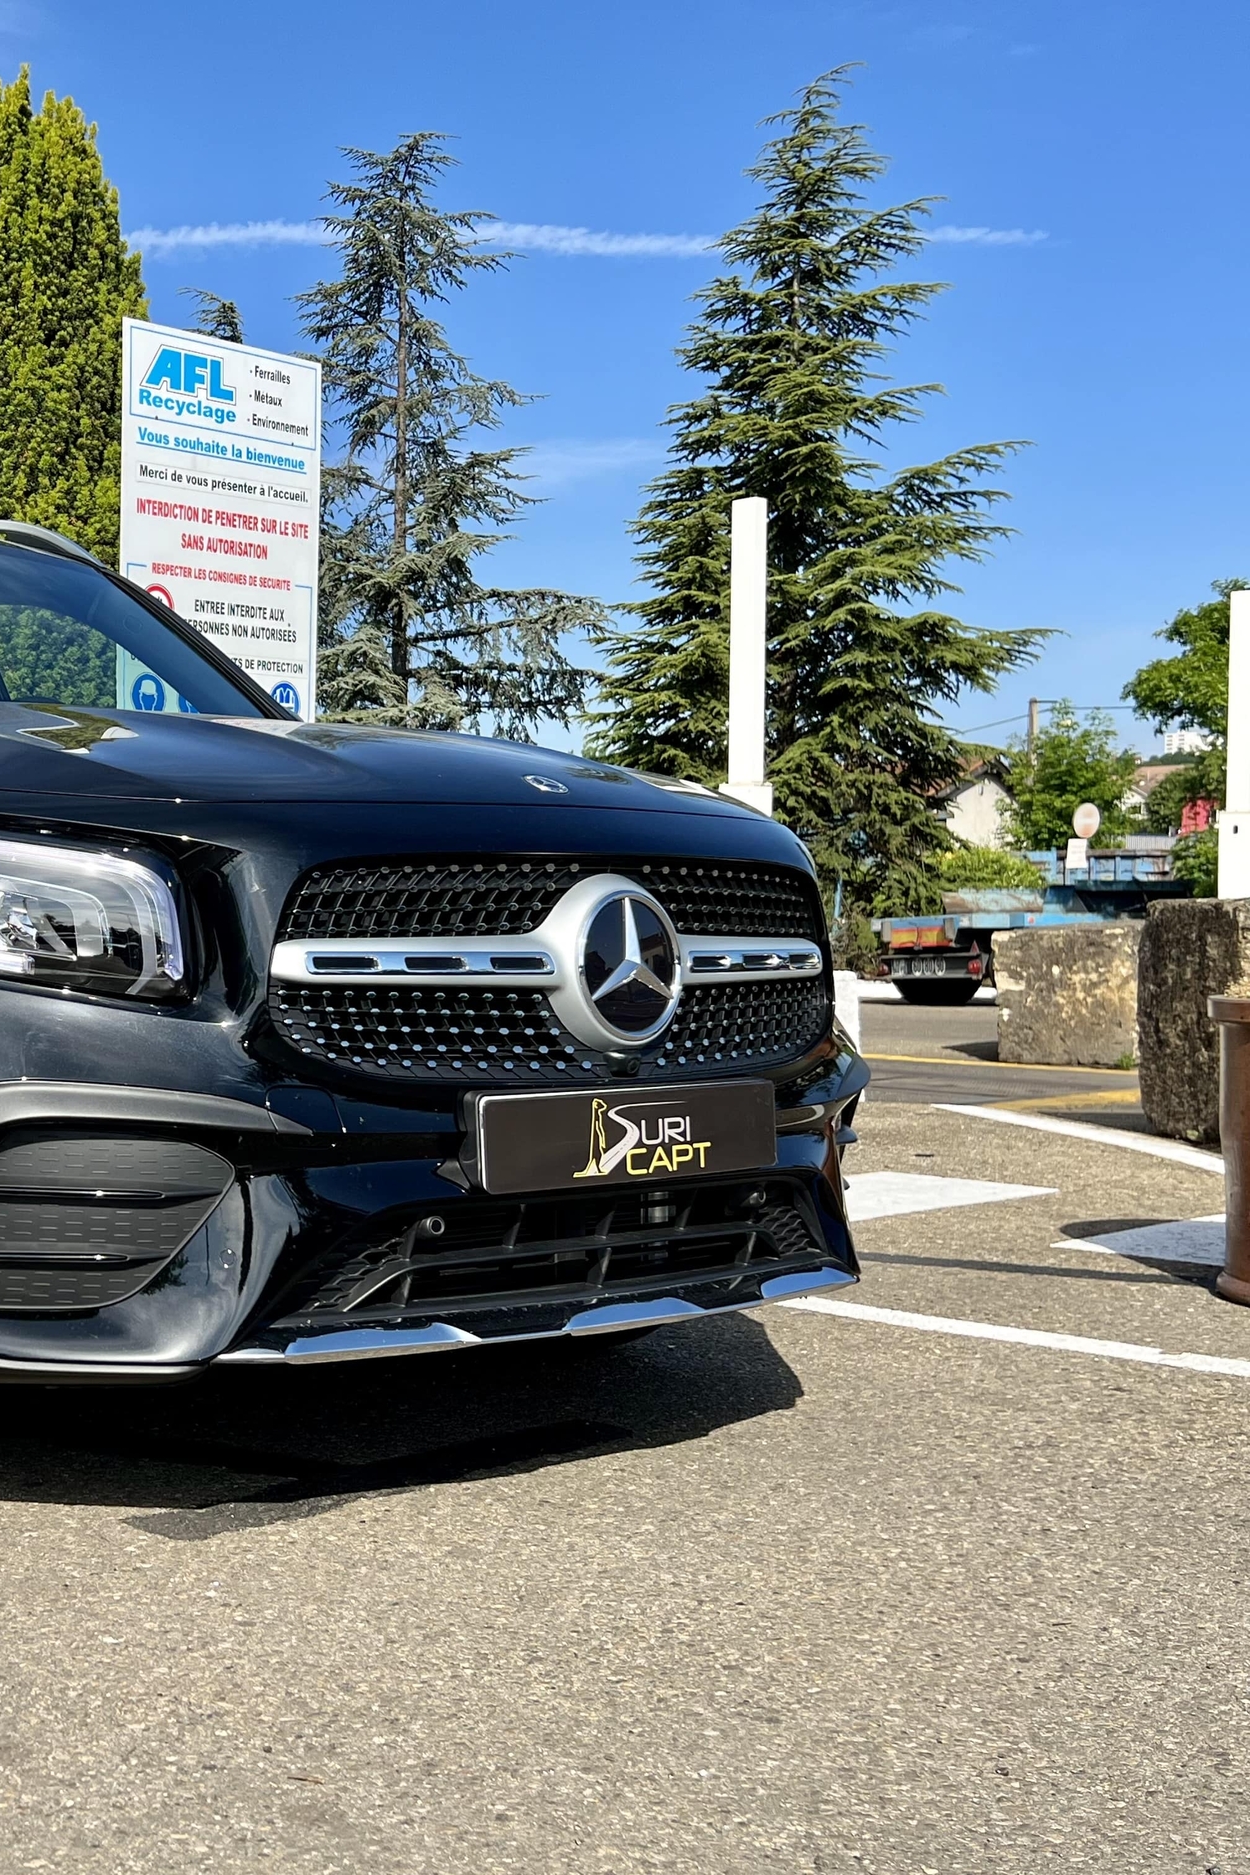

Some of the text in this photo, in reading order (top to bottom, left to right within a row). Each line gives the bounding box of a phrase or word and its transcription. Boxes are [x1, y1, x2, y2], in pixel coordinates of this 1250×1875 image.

[143, 346, 235, 404] AFL
[254, 364, 291, 385] Ferrailles
[139, 388, 236, 424] Recyclage
[252, 413, 309, 437] Environnement
[138, 426, 305, 470] Vous souhaite la bienvenue
[139, 464, 308, 503] Merci de vous présenter à l'accueil.
[137, 497, 309, 540] INTERDICTION DE PENETRER SUR LE SITE
[181, 532, 268, 560] SANS AUTORISATION
[151, 562, 291, 591] RESPECTER LES CONSIGNES DE SECURITE
[194, 599, 285, 622] ENTREE INTERDITE AUX
[231, 625, 248, 639] NON
[244, 658, 255, 670] DE
[257, 660, 303, 674] PROTECTION
[625, 1141, 712, 1175] CAPT
